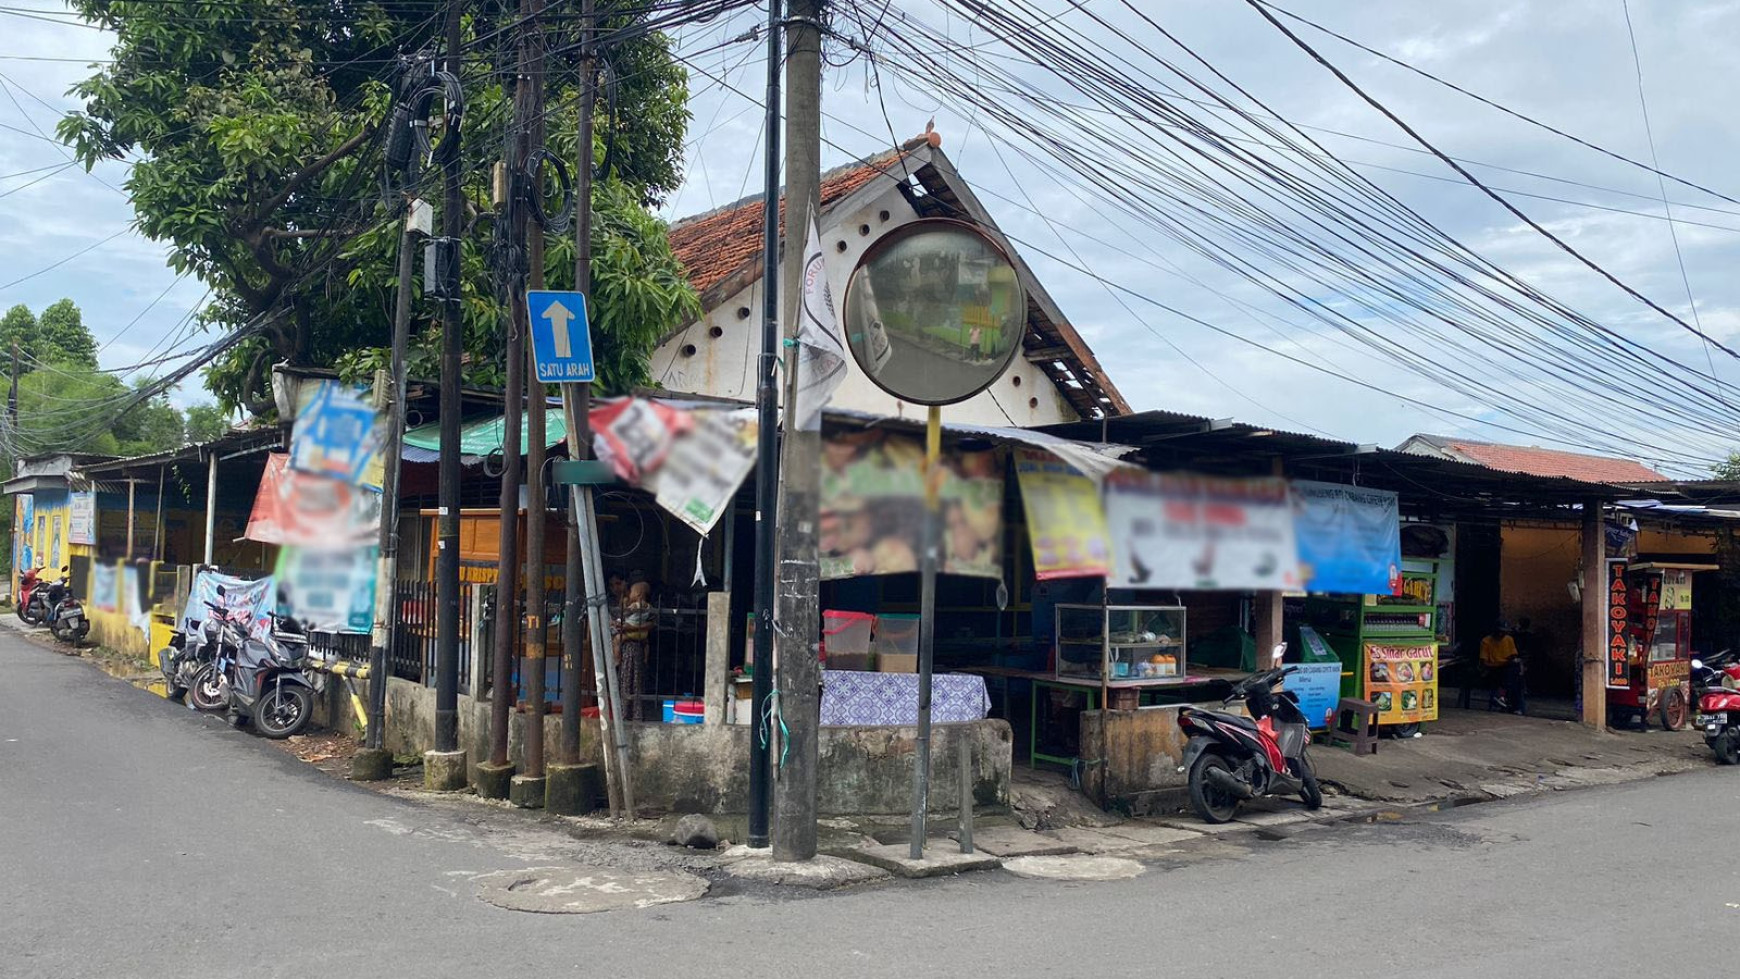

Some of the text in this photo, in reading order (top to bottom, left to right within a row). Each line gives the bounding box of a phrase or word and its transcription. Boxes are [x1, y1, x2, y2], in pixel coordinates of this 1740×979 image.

[540, 362, 591, 377] SATU ARAH
[467, 567, 498, 583] KRISPY
[1610, 564, 1628, 676] TAKOYAKI
[1382, 645, 1405, 659] Sinar
[1406, 645, 1434, 659] Garut
